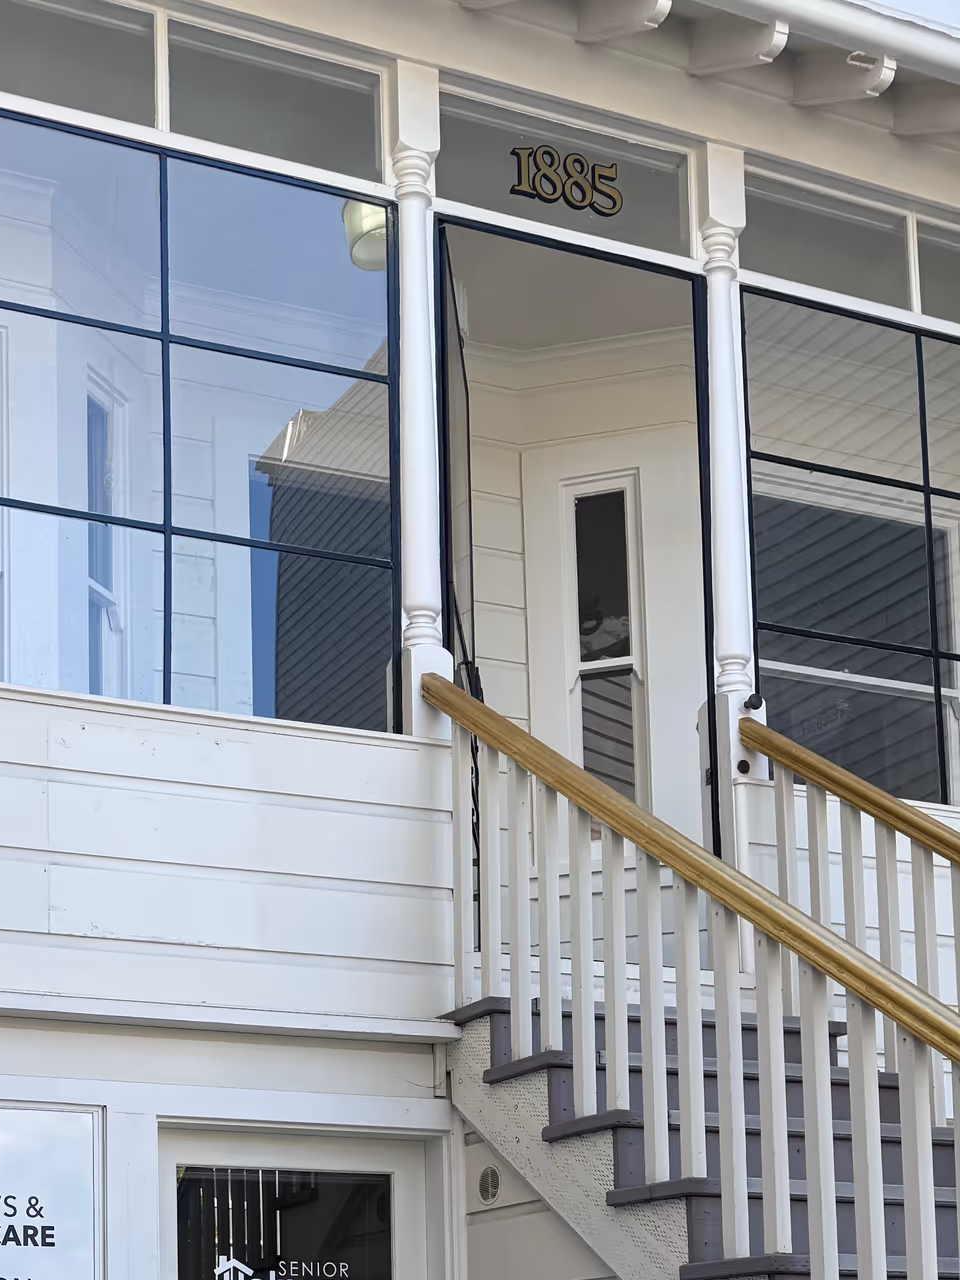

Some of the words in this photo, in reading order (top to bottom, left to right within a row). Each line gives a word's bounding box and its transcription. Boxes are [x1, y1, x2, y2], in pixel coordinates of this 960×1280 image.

[510, 145, 623, 217] 1885
[25, 1196, 45, 1218] &
[278, 1260, 349, 1277] SENIOR
